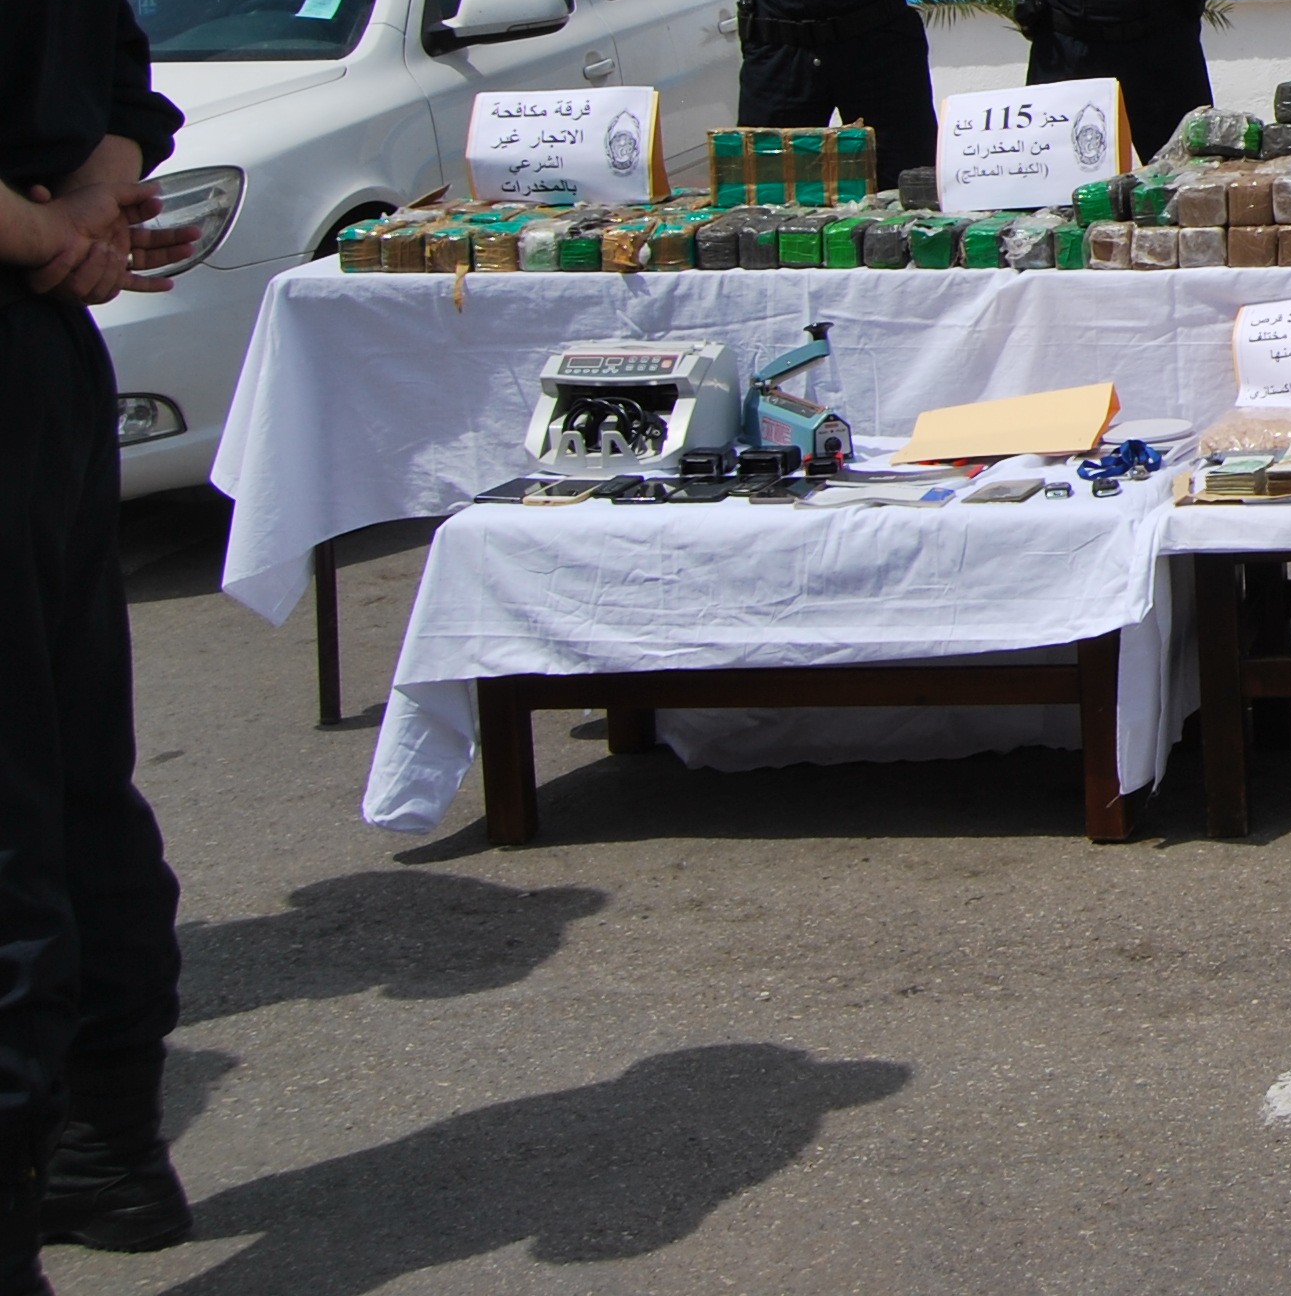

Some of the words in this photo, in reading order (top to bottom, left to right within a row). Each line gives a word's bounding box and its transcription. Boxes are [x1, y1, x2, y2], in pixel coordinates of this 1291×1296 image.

[491, 101, 547, 119] مكافحة
[554, 99, 591, 120] فرقة
[981, 103, 1033, 131] 115
[953, 119, 973, 137] كلغ
[1039, 111, 1069, 128] حجز
[490, 128, 520, 149] غير
[530, 128, 584, 149] الاتجار
[962, 140, 1025, 159] المخدرات
[1030, 141, 1050, 156] من
[508, 155, 564, 174] الشرعي
[501, 179, 578, 198] بالمخدرات
[1250, 314, 1283, 327] قرص
[1248, 330, 1287, 343] مختلف
